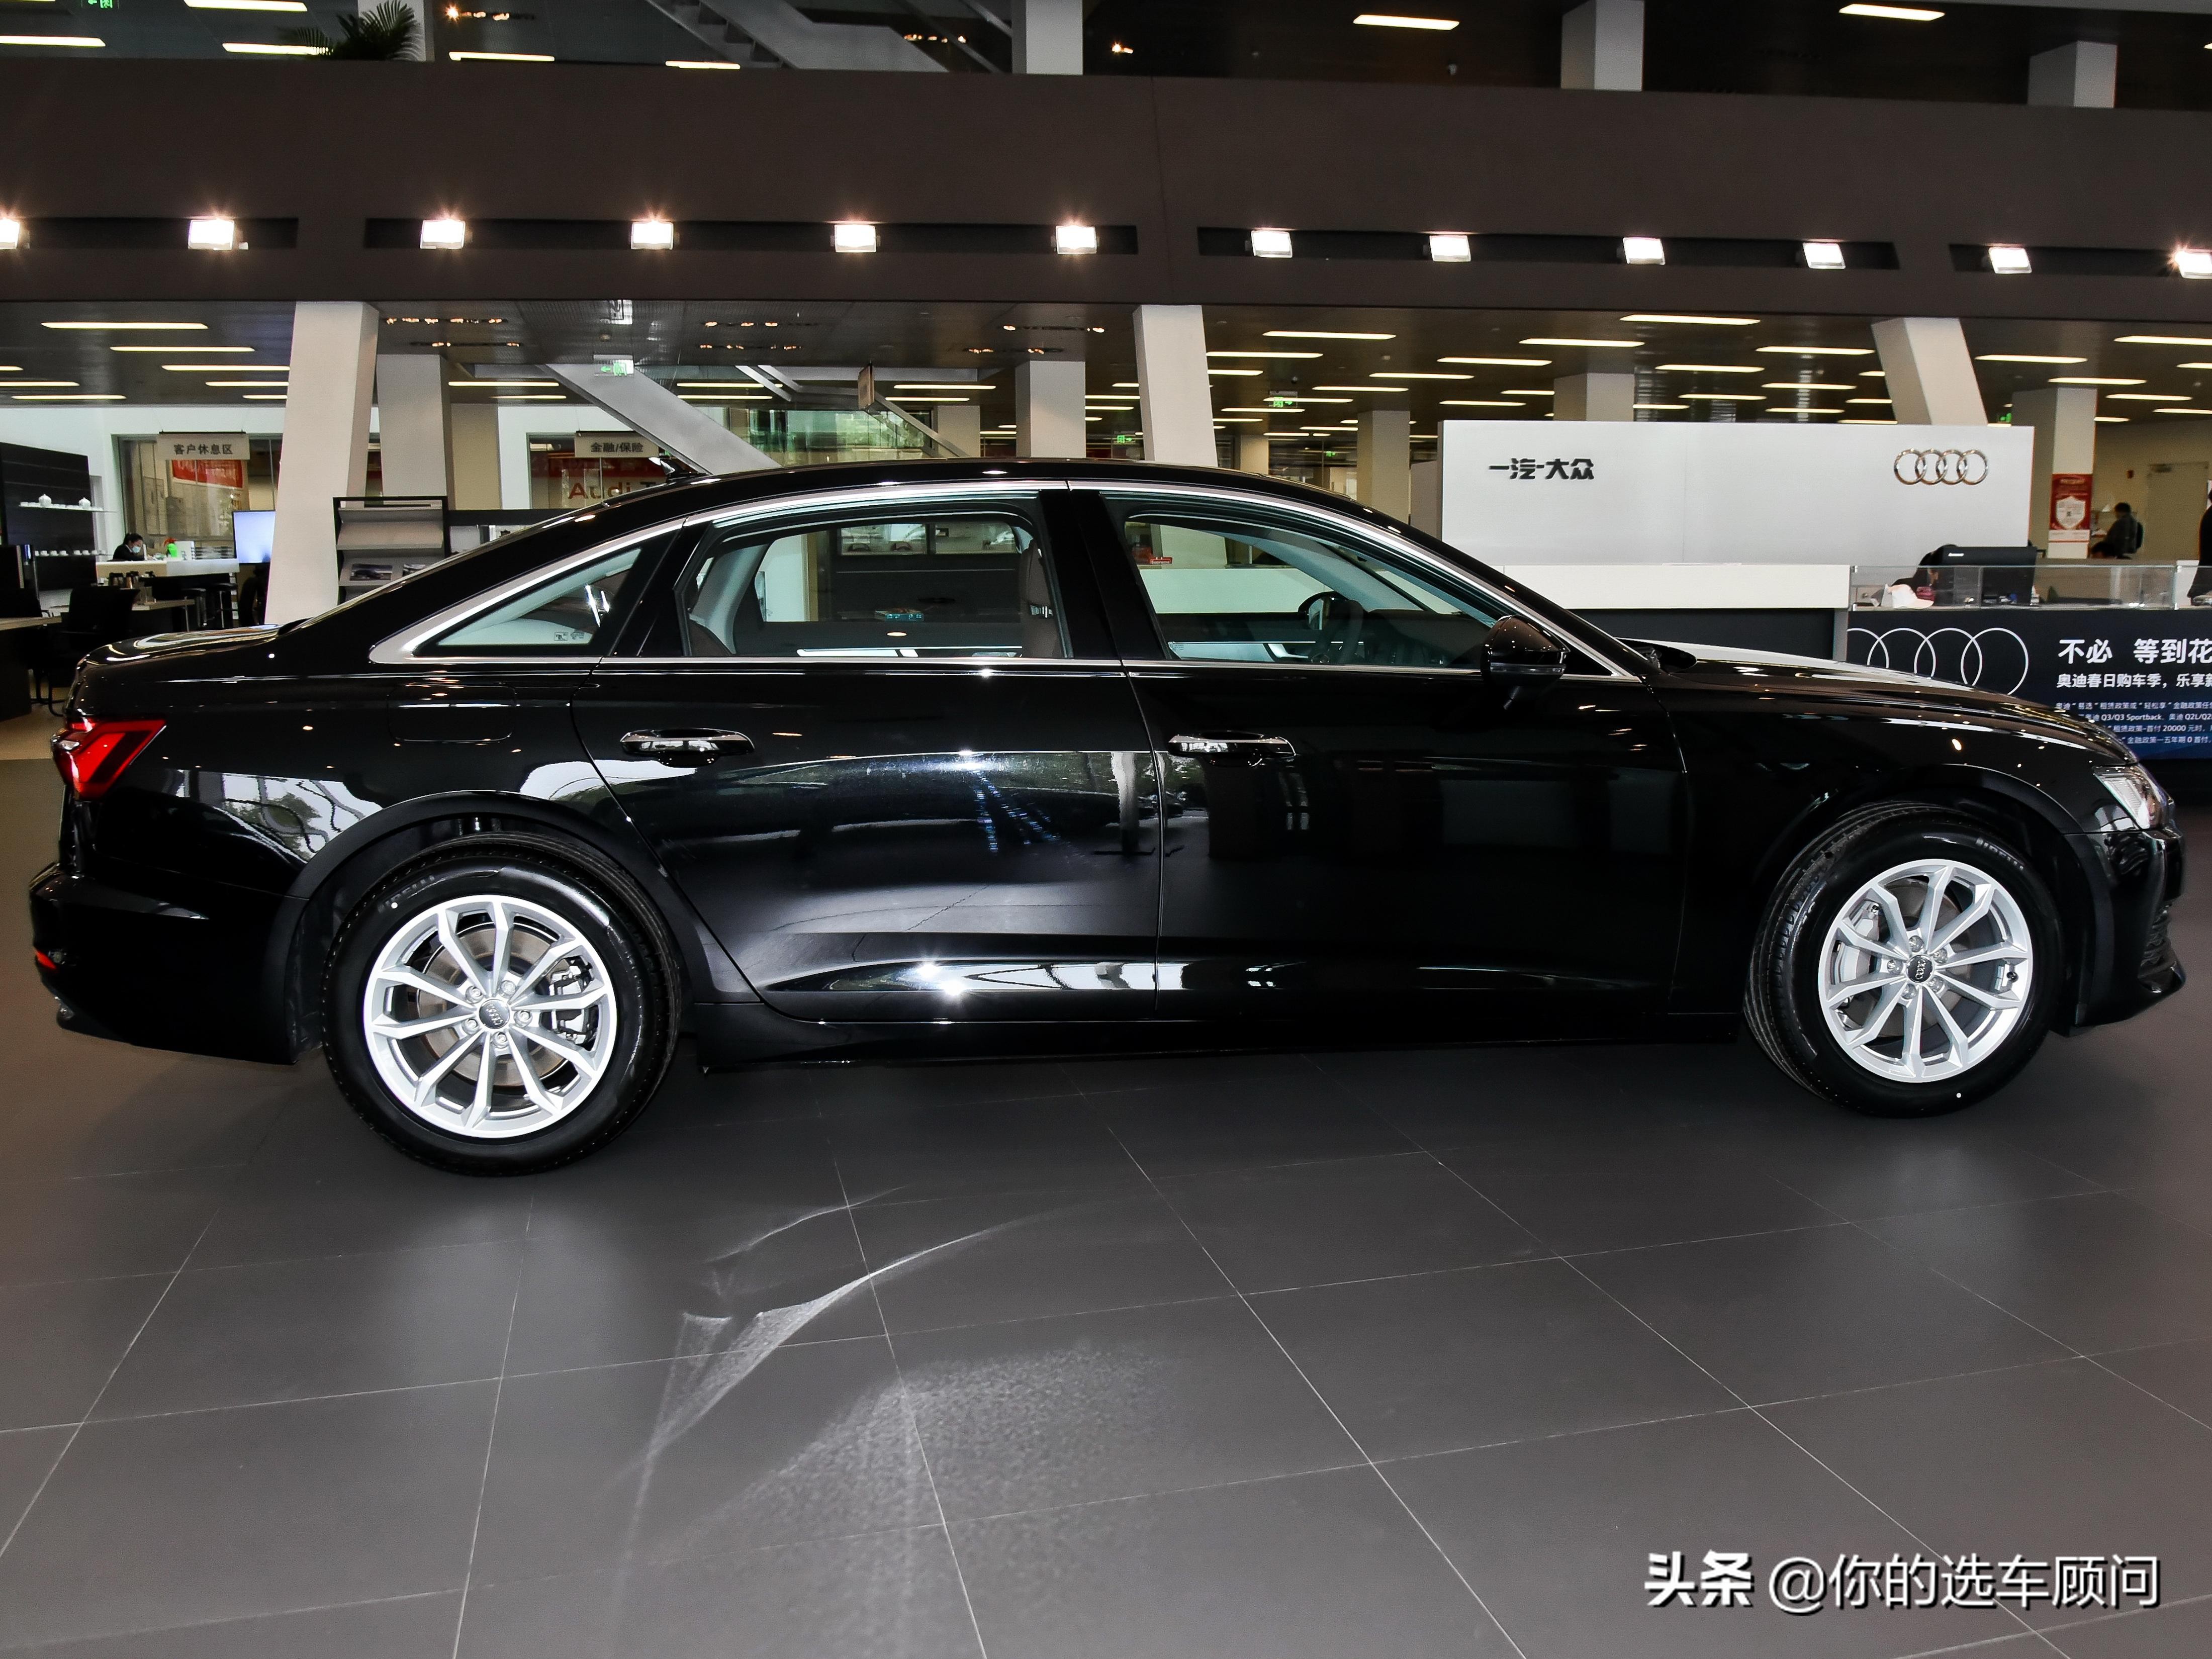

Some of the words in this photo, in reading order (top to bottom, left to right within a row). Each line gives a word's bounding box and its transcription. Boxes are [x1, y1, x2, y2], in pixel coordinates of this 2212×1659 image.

[173, 443, 233, 455] 客户休息区
[591, 442, 643, 452] 金融/保险
[2058, 638, 2113, 664] 不必
[2133, 638, 2212, 664] 等到花
